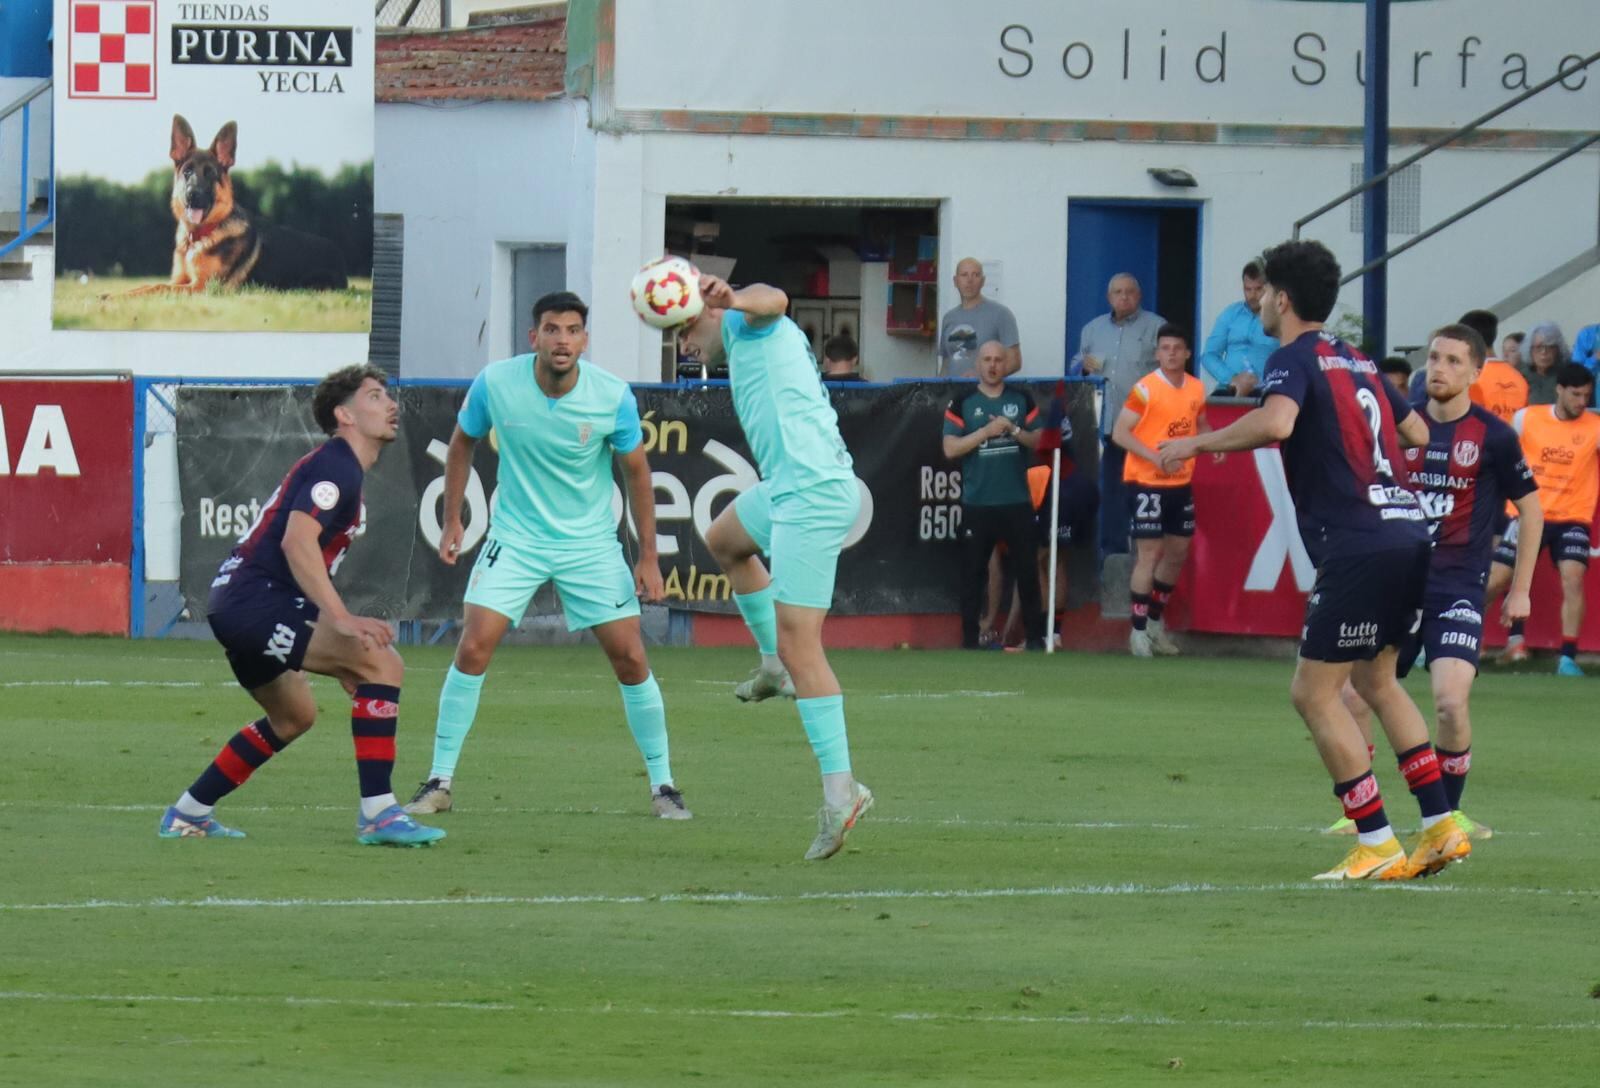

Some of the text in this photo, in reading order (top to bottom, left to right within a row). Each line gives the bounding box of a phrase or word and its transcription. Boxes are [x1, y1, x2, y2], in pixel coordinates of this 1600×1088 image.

[178, 4, 269, 22] TIENDAS
[177, 29, 346, 62] PURINA
[998, 24, 1227, 83] Solid
[258, 71, 345, 94] YECLA
[0, 404, 80, 475] A
[1356, 388, 1393, 477] 2
[1136, 493, 1162, 518] 23
[920, 505, 962, 541] 650
[1337, 636, 1377, 648] confort
[1340, 622, 1378, 637] tutto
[1440, 631, 1478, 650] GOBIK
